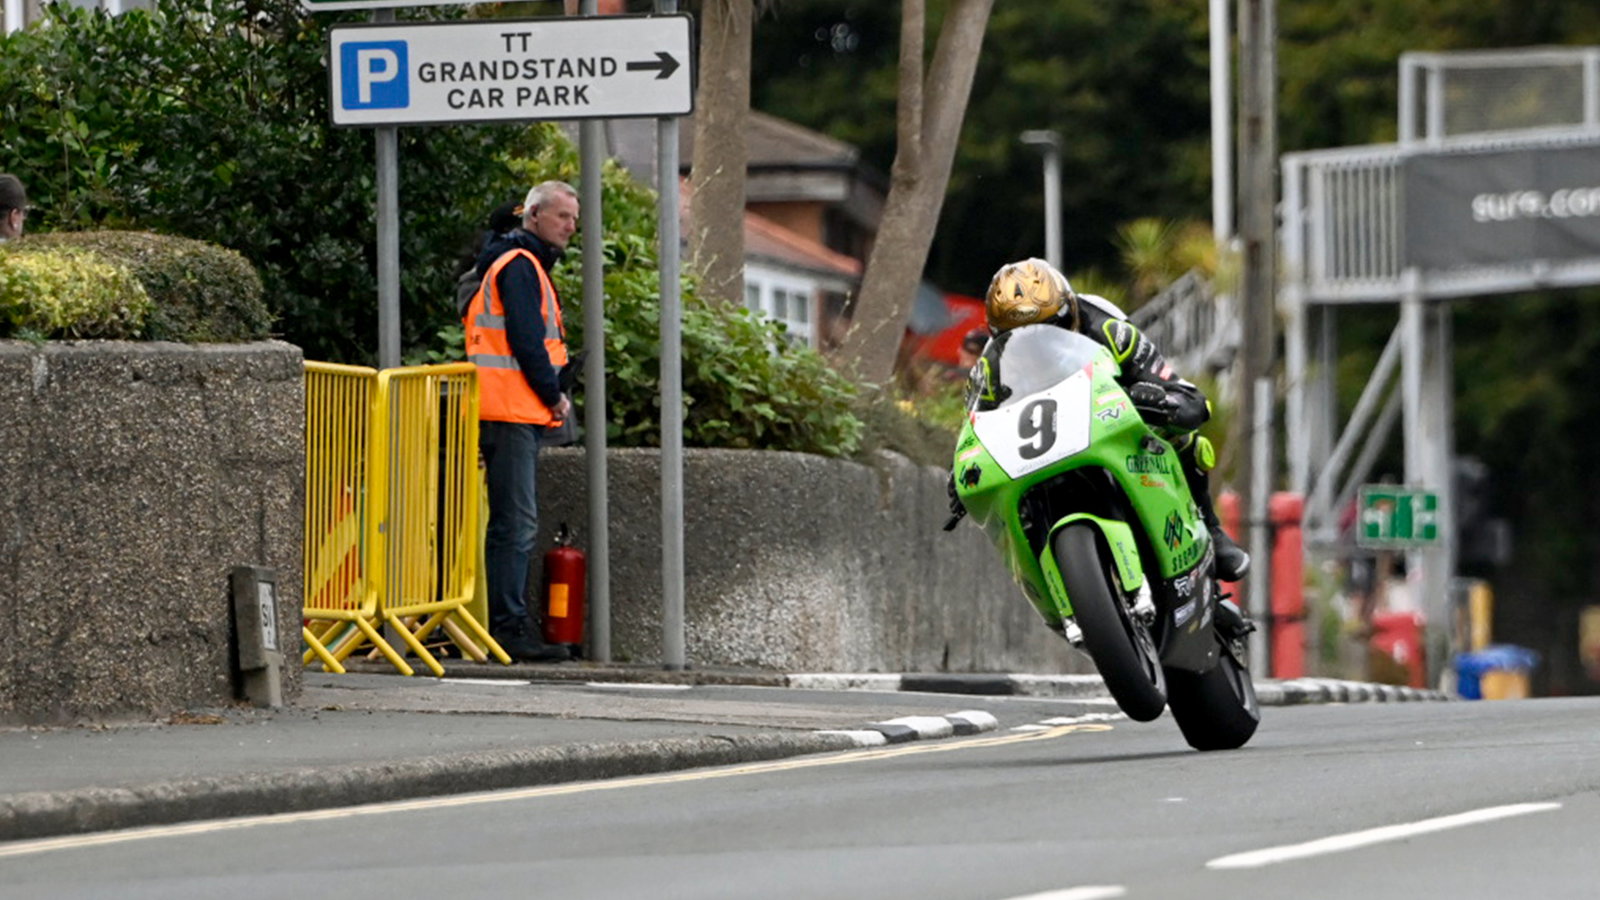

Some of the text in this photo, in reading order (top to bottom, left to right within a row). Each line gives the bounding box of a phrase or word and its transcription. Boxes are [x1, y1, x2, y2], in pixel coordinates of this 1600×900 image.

[502, 31, 533, 53] TT
[357, 48, 400, 104] P
[418, 56, 618, 83] GRANDSTAND
[447, 84, 591, 110] CAR PARK
[1018, 398, 1058, 460] 9
